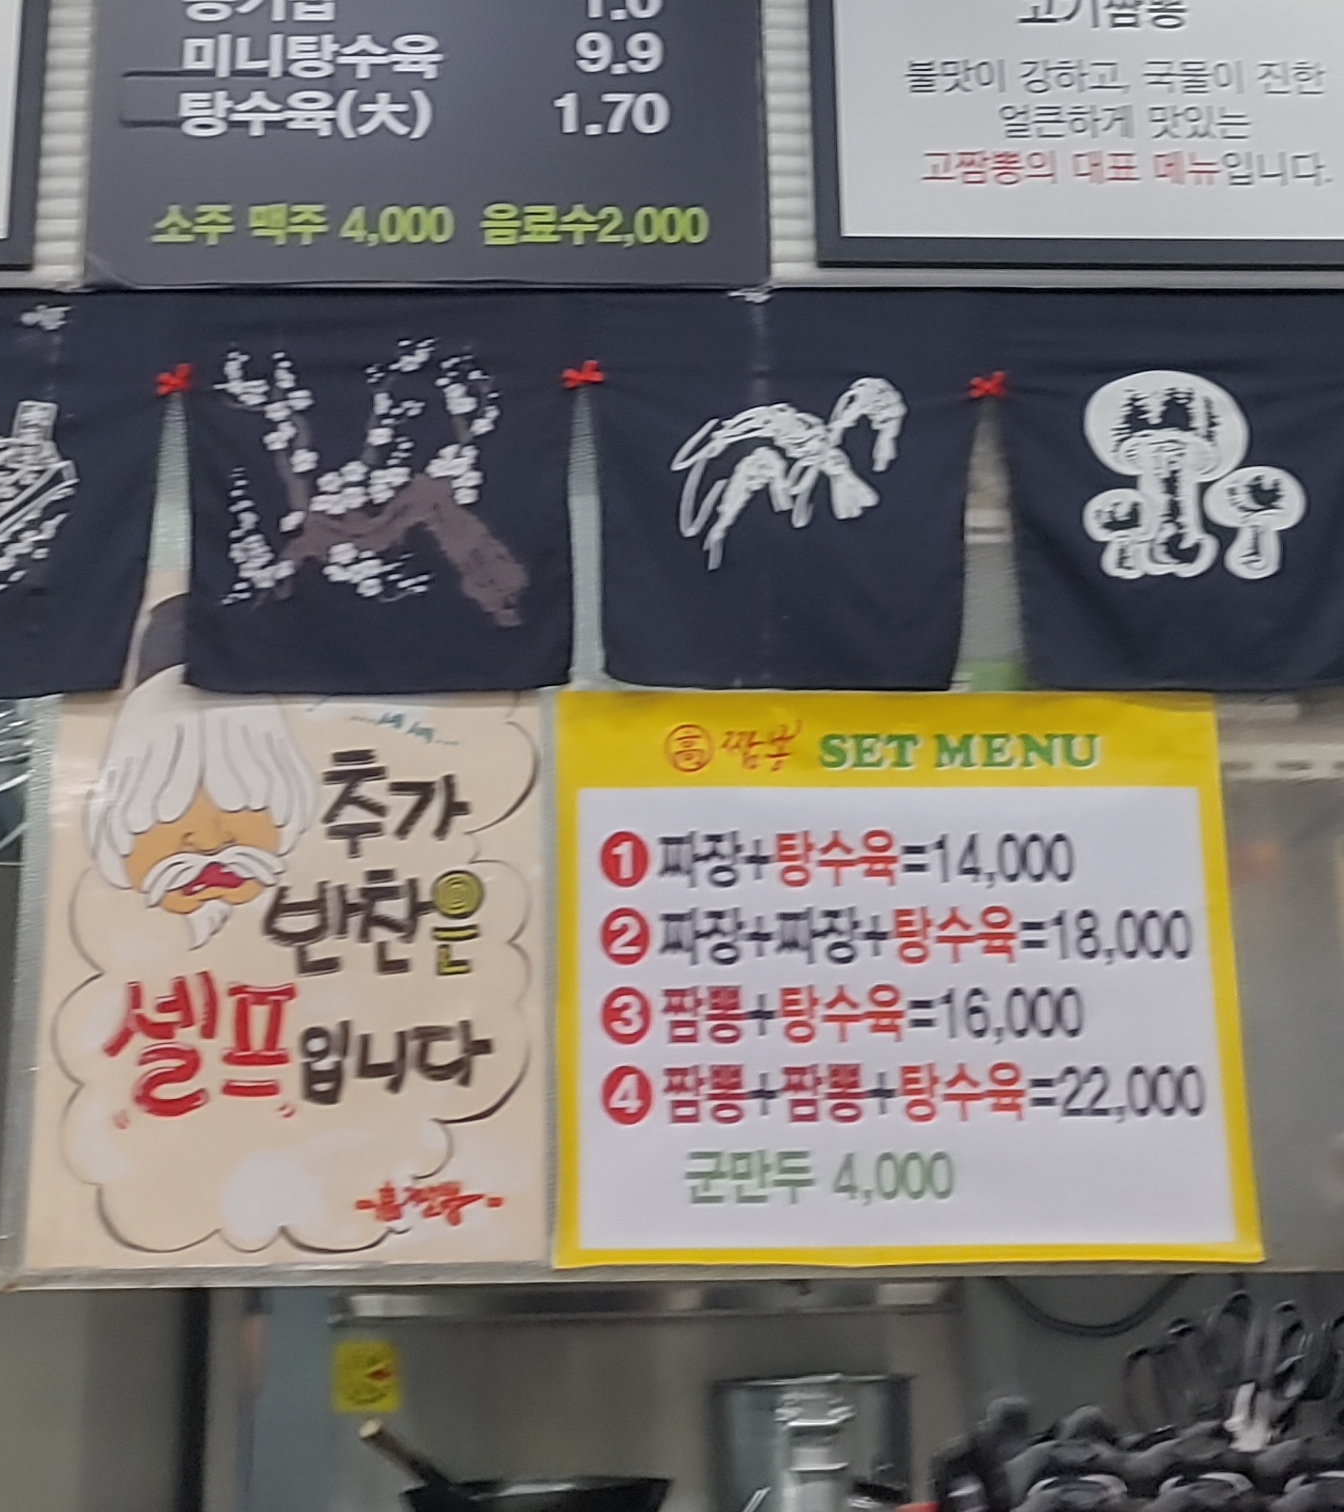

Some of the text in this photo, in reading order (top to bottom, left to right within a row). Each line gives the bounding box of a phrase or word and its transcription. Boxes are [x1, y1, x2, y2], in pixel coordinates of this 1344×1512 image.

[182, 32, 665, 80] 미니탕수육 9.9
[905, 59, 1006, 96] 불맛이
[1142, 61, 1246, 94] 국물이
[1256, 61, 1327, 96] 진한
[178, 89, 670, 139] 탕수육(大) 1.70
[997, 104, 1252, 142] 얼큰하게 맛있는
[921, 150, 1059, 186] 고짬뽕의
[1072, 151, 1142, 184] 대표
[151, 202, 711, 248] 소주 맥주 4,000 음료수2,000
[818, 733, 921, 770] SET
[934, 733, 1101, 769] MENU
[321, 748, 471, 858] 추가
[262, 868, 485, 976] 반찬은
[102, 970, 492, 1118] 셀프입니다
[685, 1150, 954, 1204] 군만두 4,000
